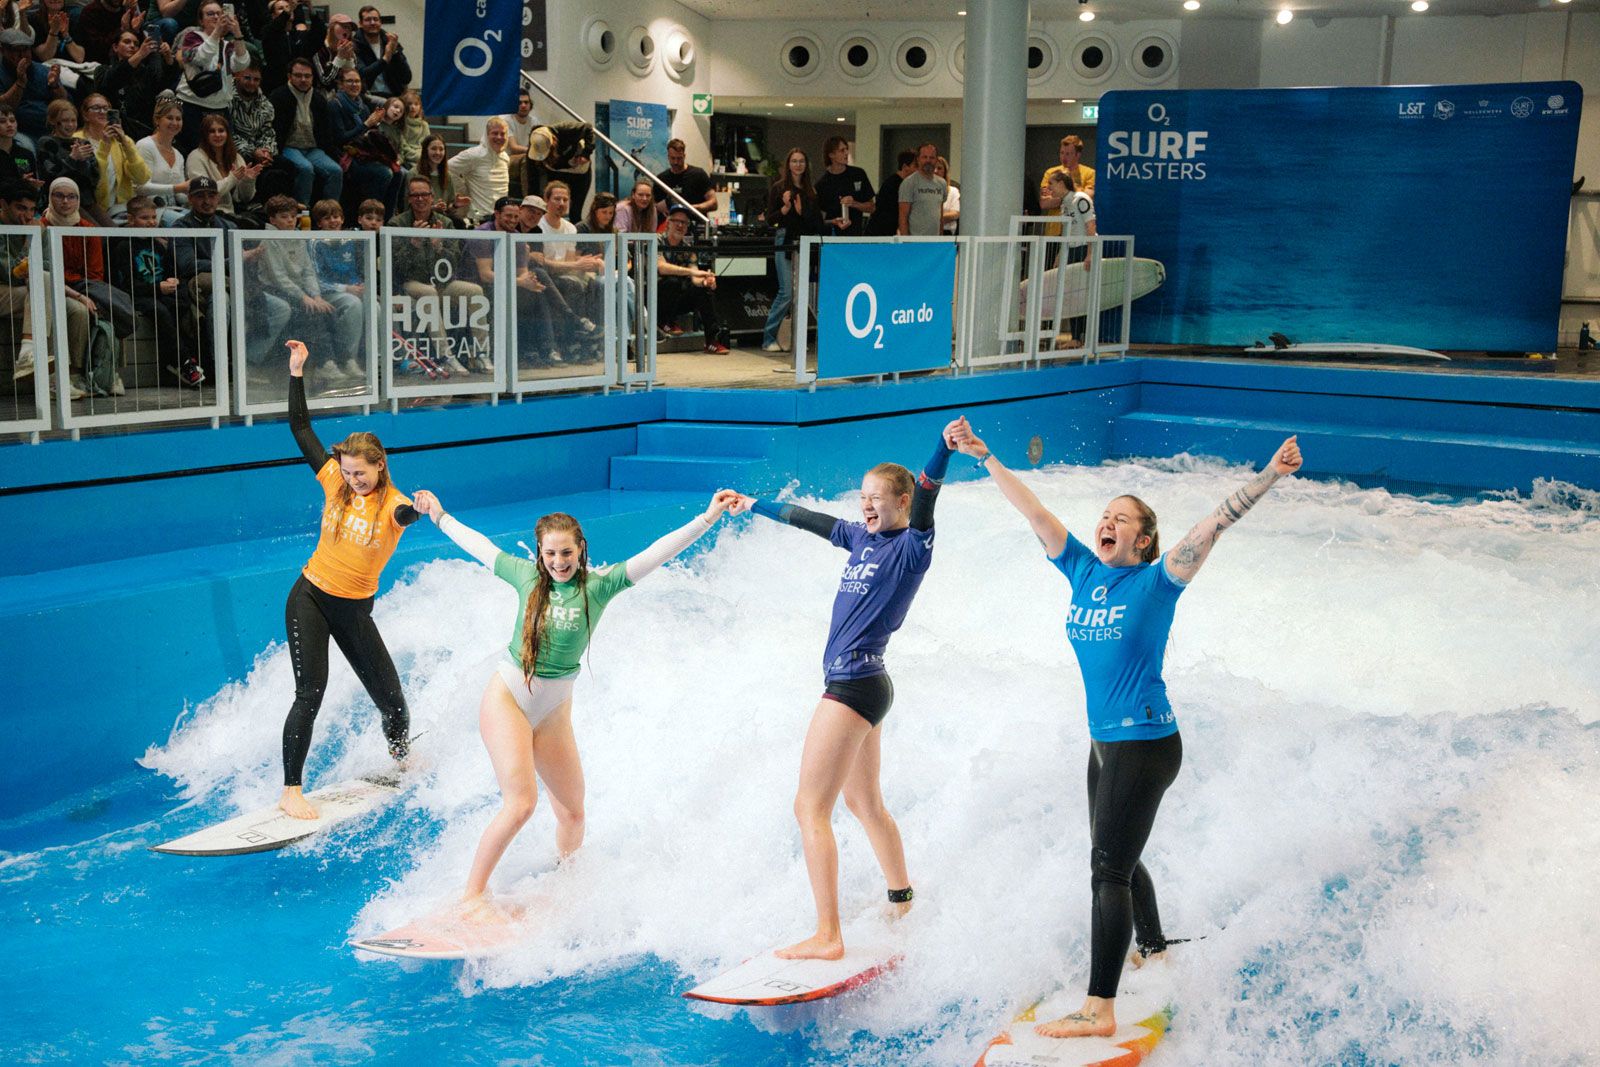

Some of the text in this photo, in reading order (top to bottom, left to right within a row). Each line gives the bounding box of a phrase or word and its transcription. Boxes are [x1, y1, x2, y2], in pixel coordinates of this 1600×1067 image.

[476, 0, 487, 18] ca
[1398, 102, 1426, 115] L&T
[627, 116, 653, 129] SURF
[1107, 131, 1208, 160] SURF
[1107, 162, 1207, 180] MASTERS
[845, 282, 933, 349] O2 can do
